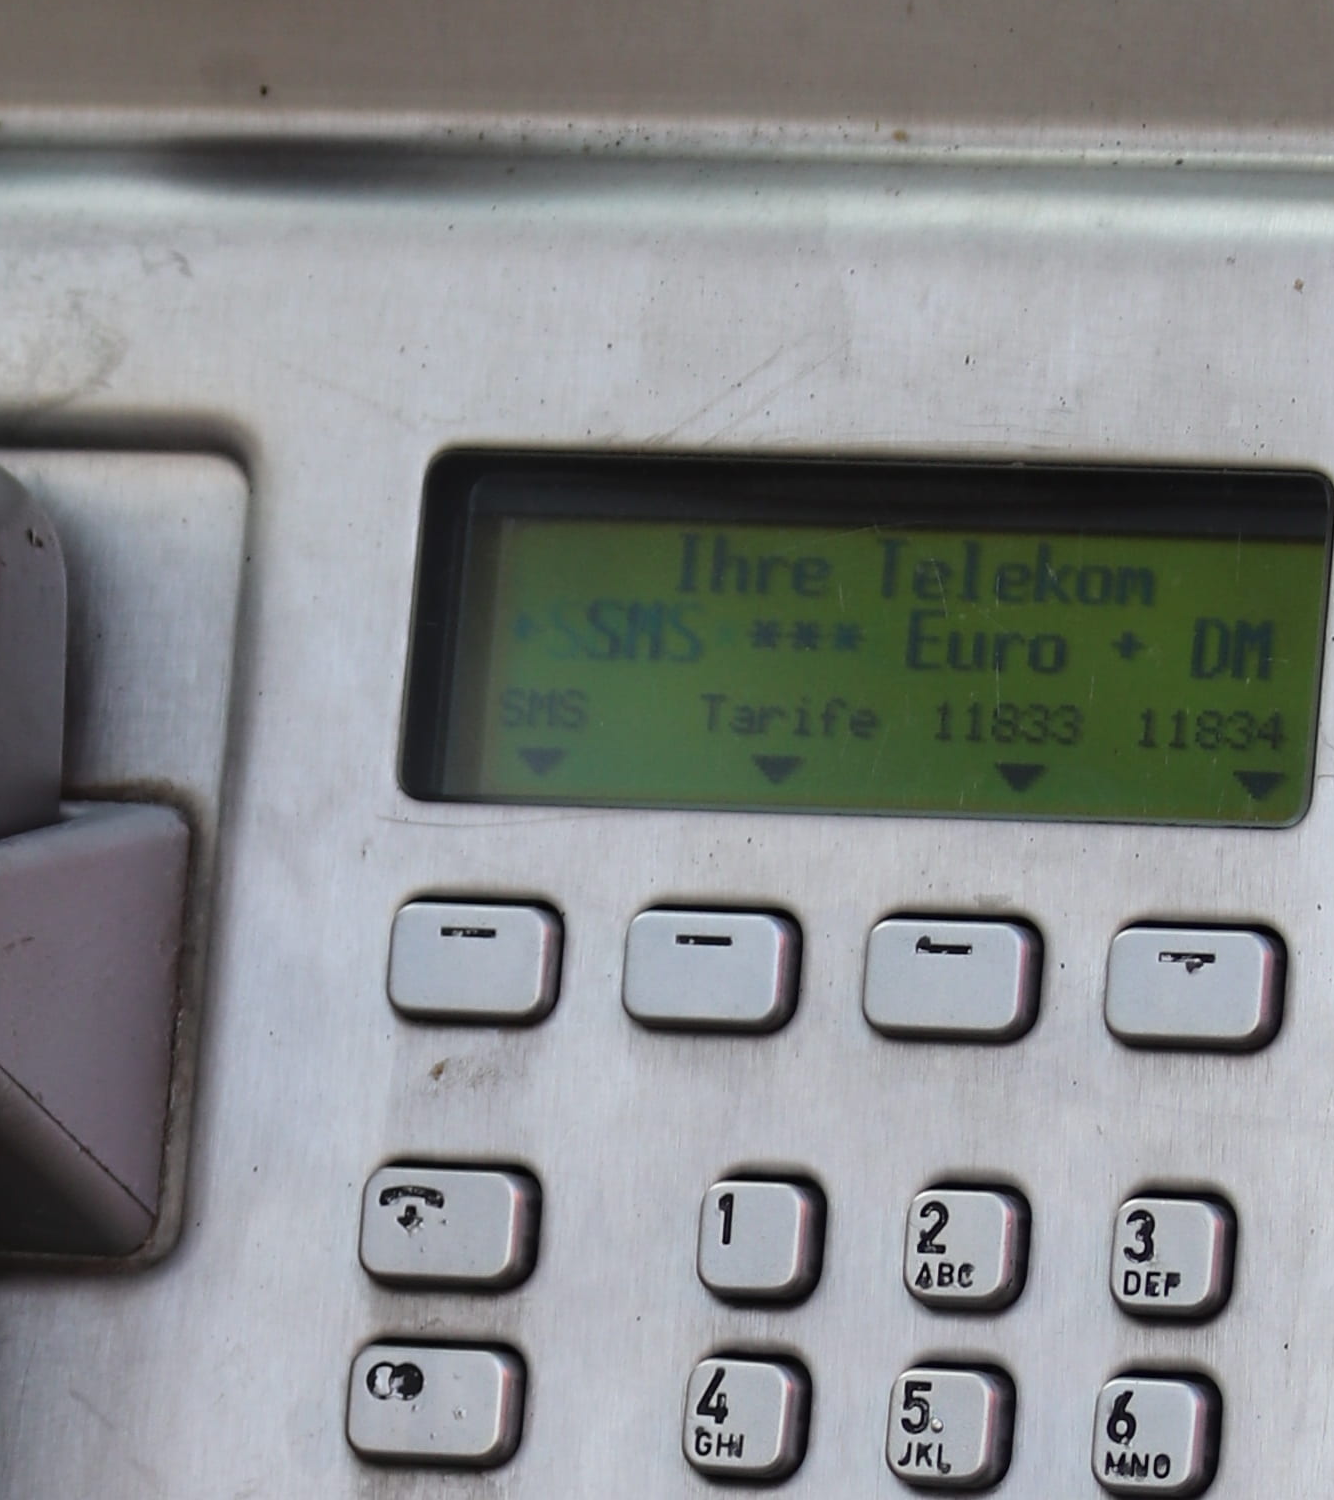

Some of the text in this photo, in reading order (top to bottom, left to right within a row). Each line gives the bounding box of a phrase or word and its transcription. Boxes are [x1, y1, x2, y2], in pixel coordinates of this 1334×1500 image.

[677, 532, 1157, 608] Ihre Telekom
[905, 607, 1068, 675] Euro
[1191, 615, 1276, 681] DM
[499, 687, 1285, 750] SMS Tarife 11833 11834
[717, 1191, 736, 1246] 1
[915, 1199, 950, 1256] 2
[1122, 1208, 1157, 1265] 3
[913, 1260, 975, 1291] ABC
[1122, 1269, 1182, 1299] DEF
[695, 1366, 730, 1426] 4
[899, 1379, 931, 1436] 5
[1105, 1389, 1138, 1447] 6
[692, 1428, 746, 1461] GHI
[895, 1440, 953, 1476] JKL
[1102, 1451, 1173, 1483] MNO
